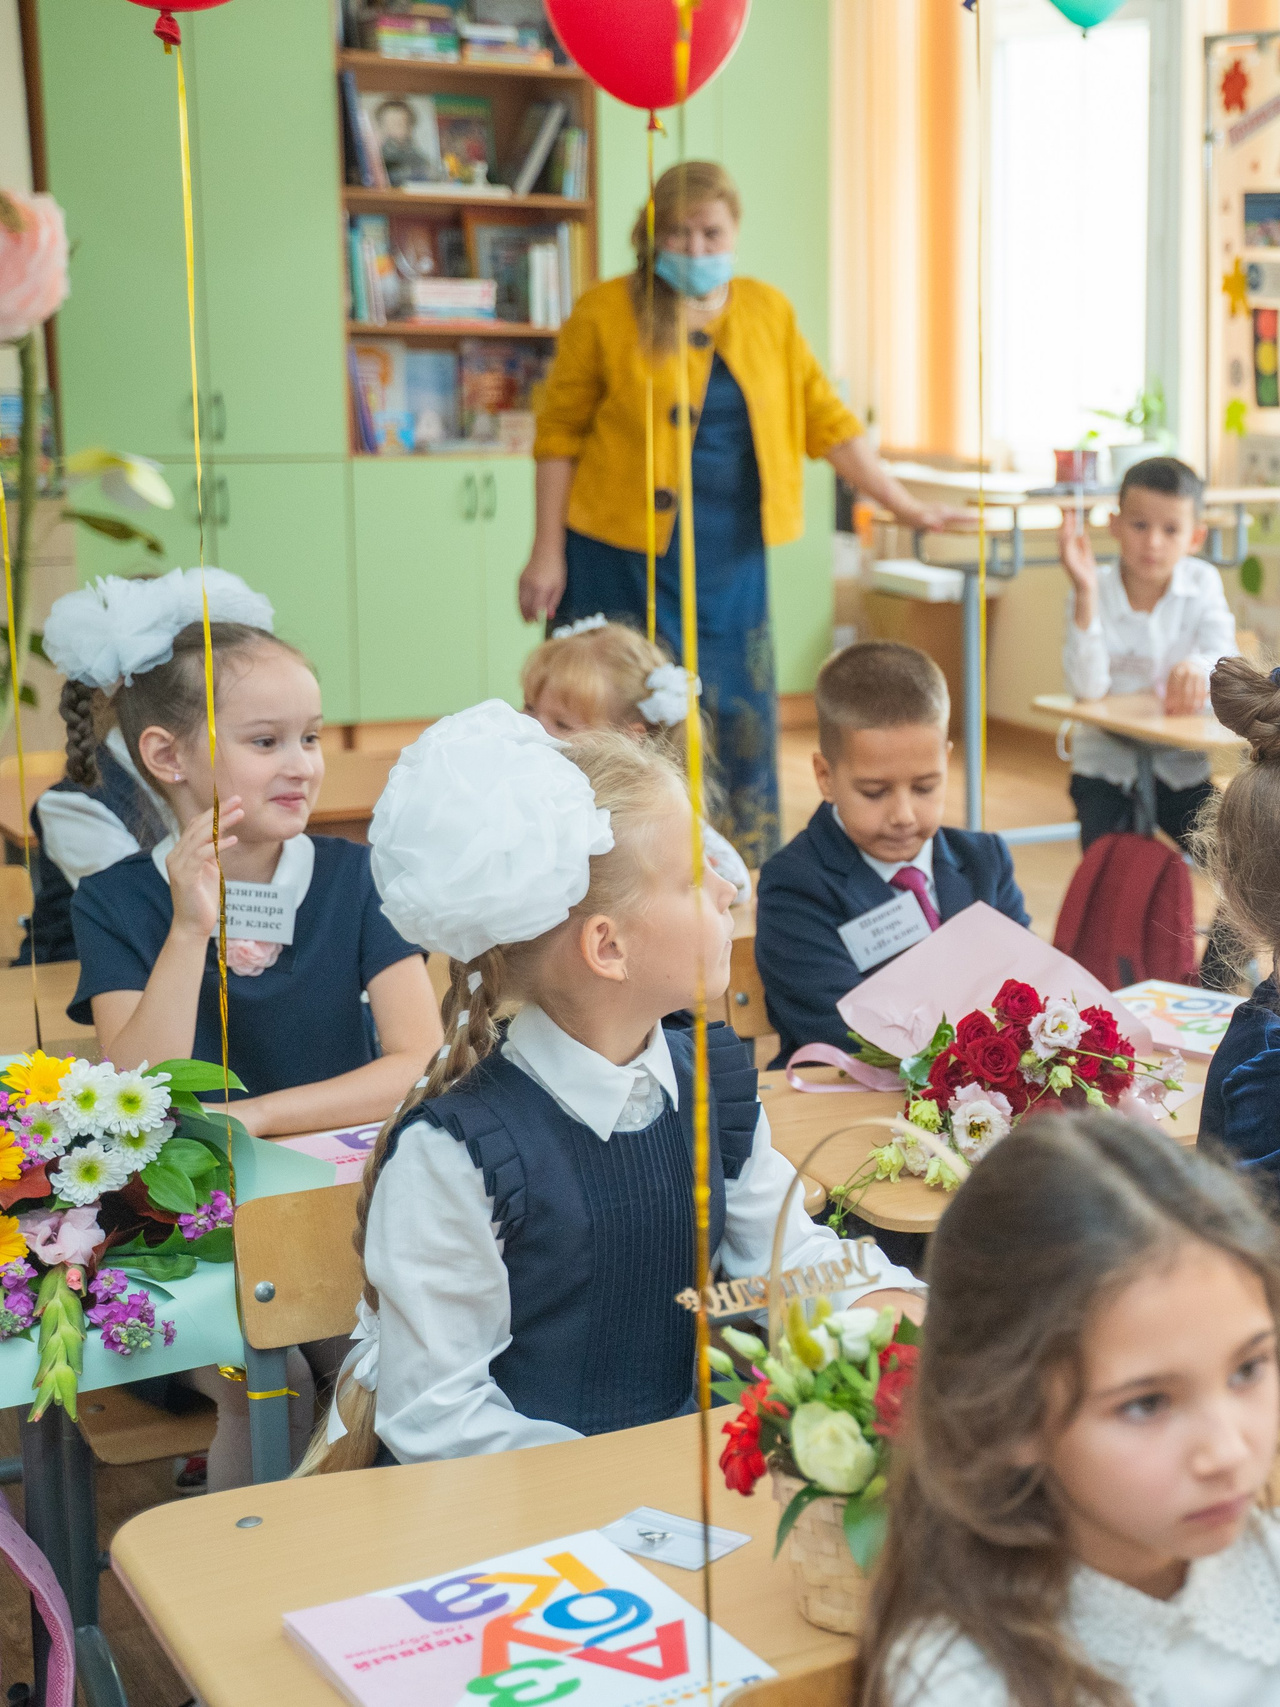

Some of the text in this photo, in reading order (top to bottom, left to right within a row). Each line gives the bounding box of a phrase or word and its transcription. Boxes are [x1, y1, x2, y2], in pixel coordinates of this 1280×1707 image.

[225, 887, 278, 899] алягина
[225, 903, 284, 916] ександра
[246, 919, 282, 930] класс
[353, 1633, 475, 1672] Первый
